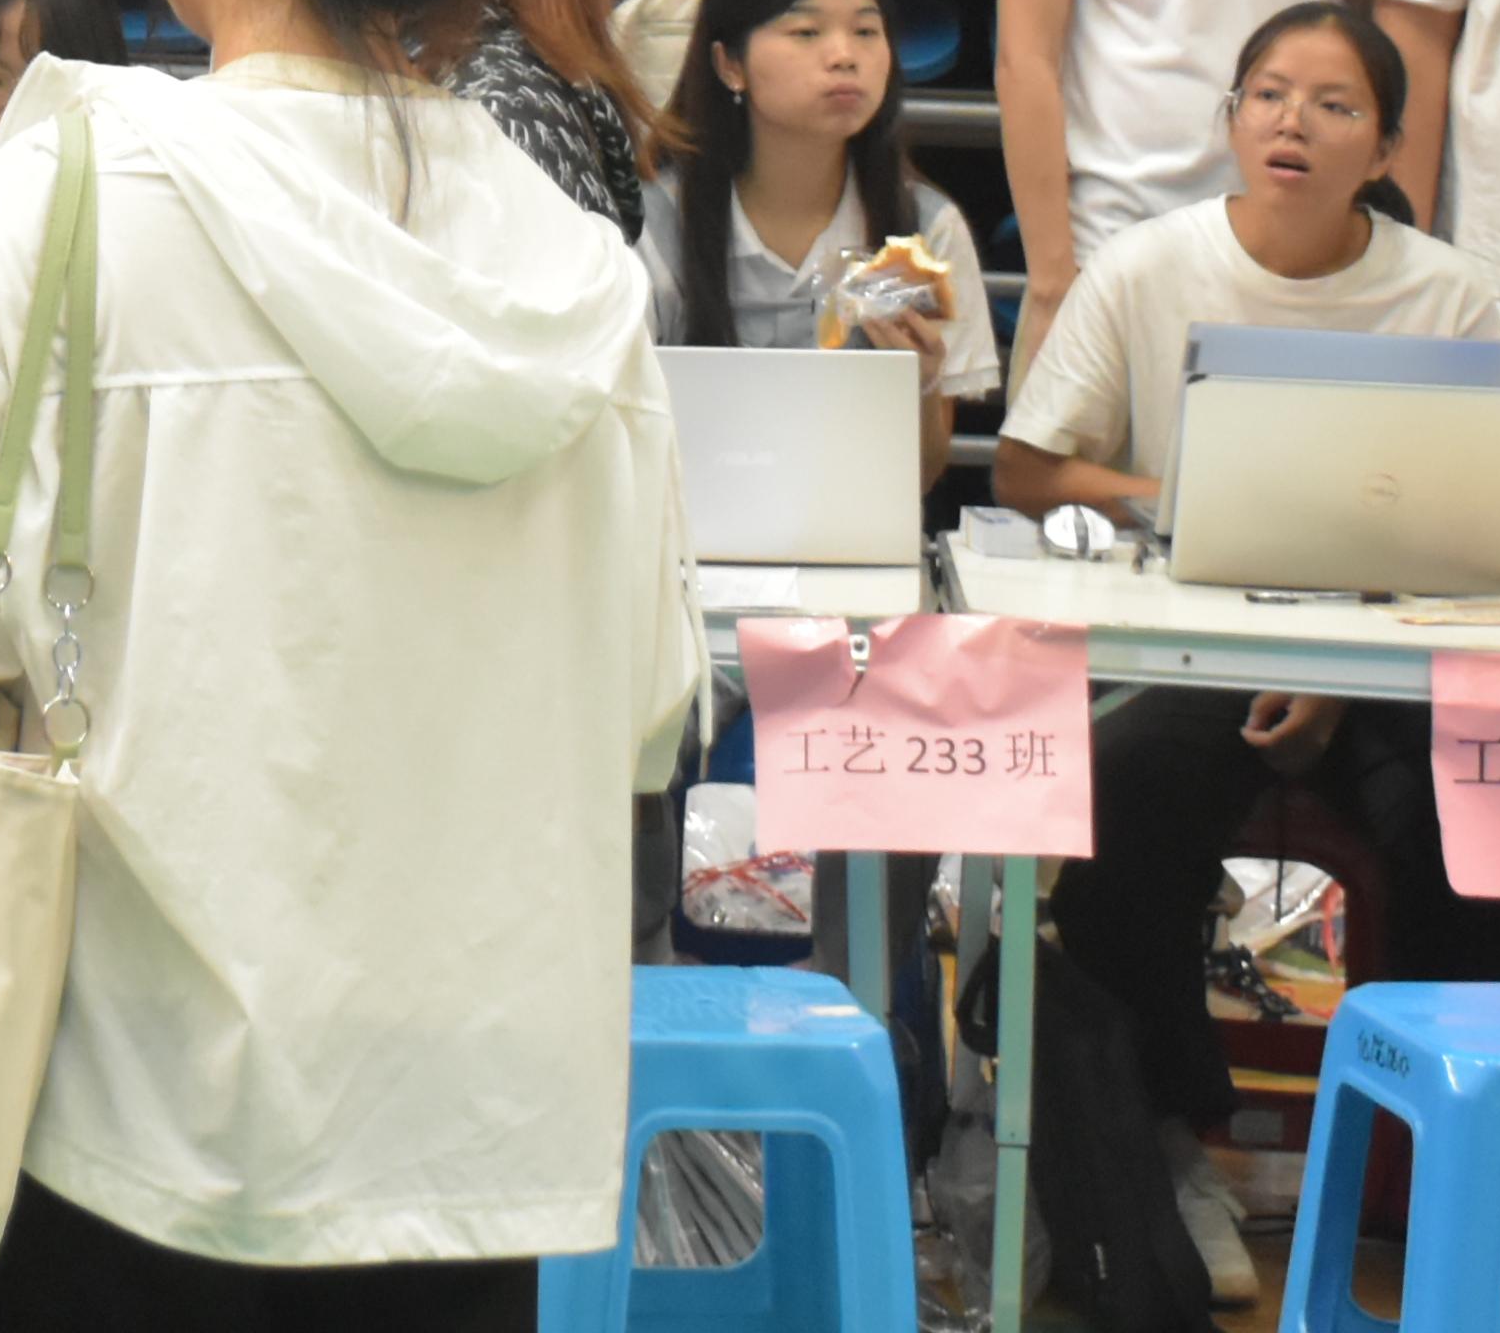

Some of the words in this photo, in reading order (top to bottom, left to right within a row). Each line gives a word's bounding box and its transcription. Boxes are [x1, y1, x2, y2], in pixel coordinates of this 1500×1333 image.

[784, 724, 887, 775] 工艺
[905, 736, 987, 776] 233
[1004, 730, 1058, 780] 班
